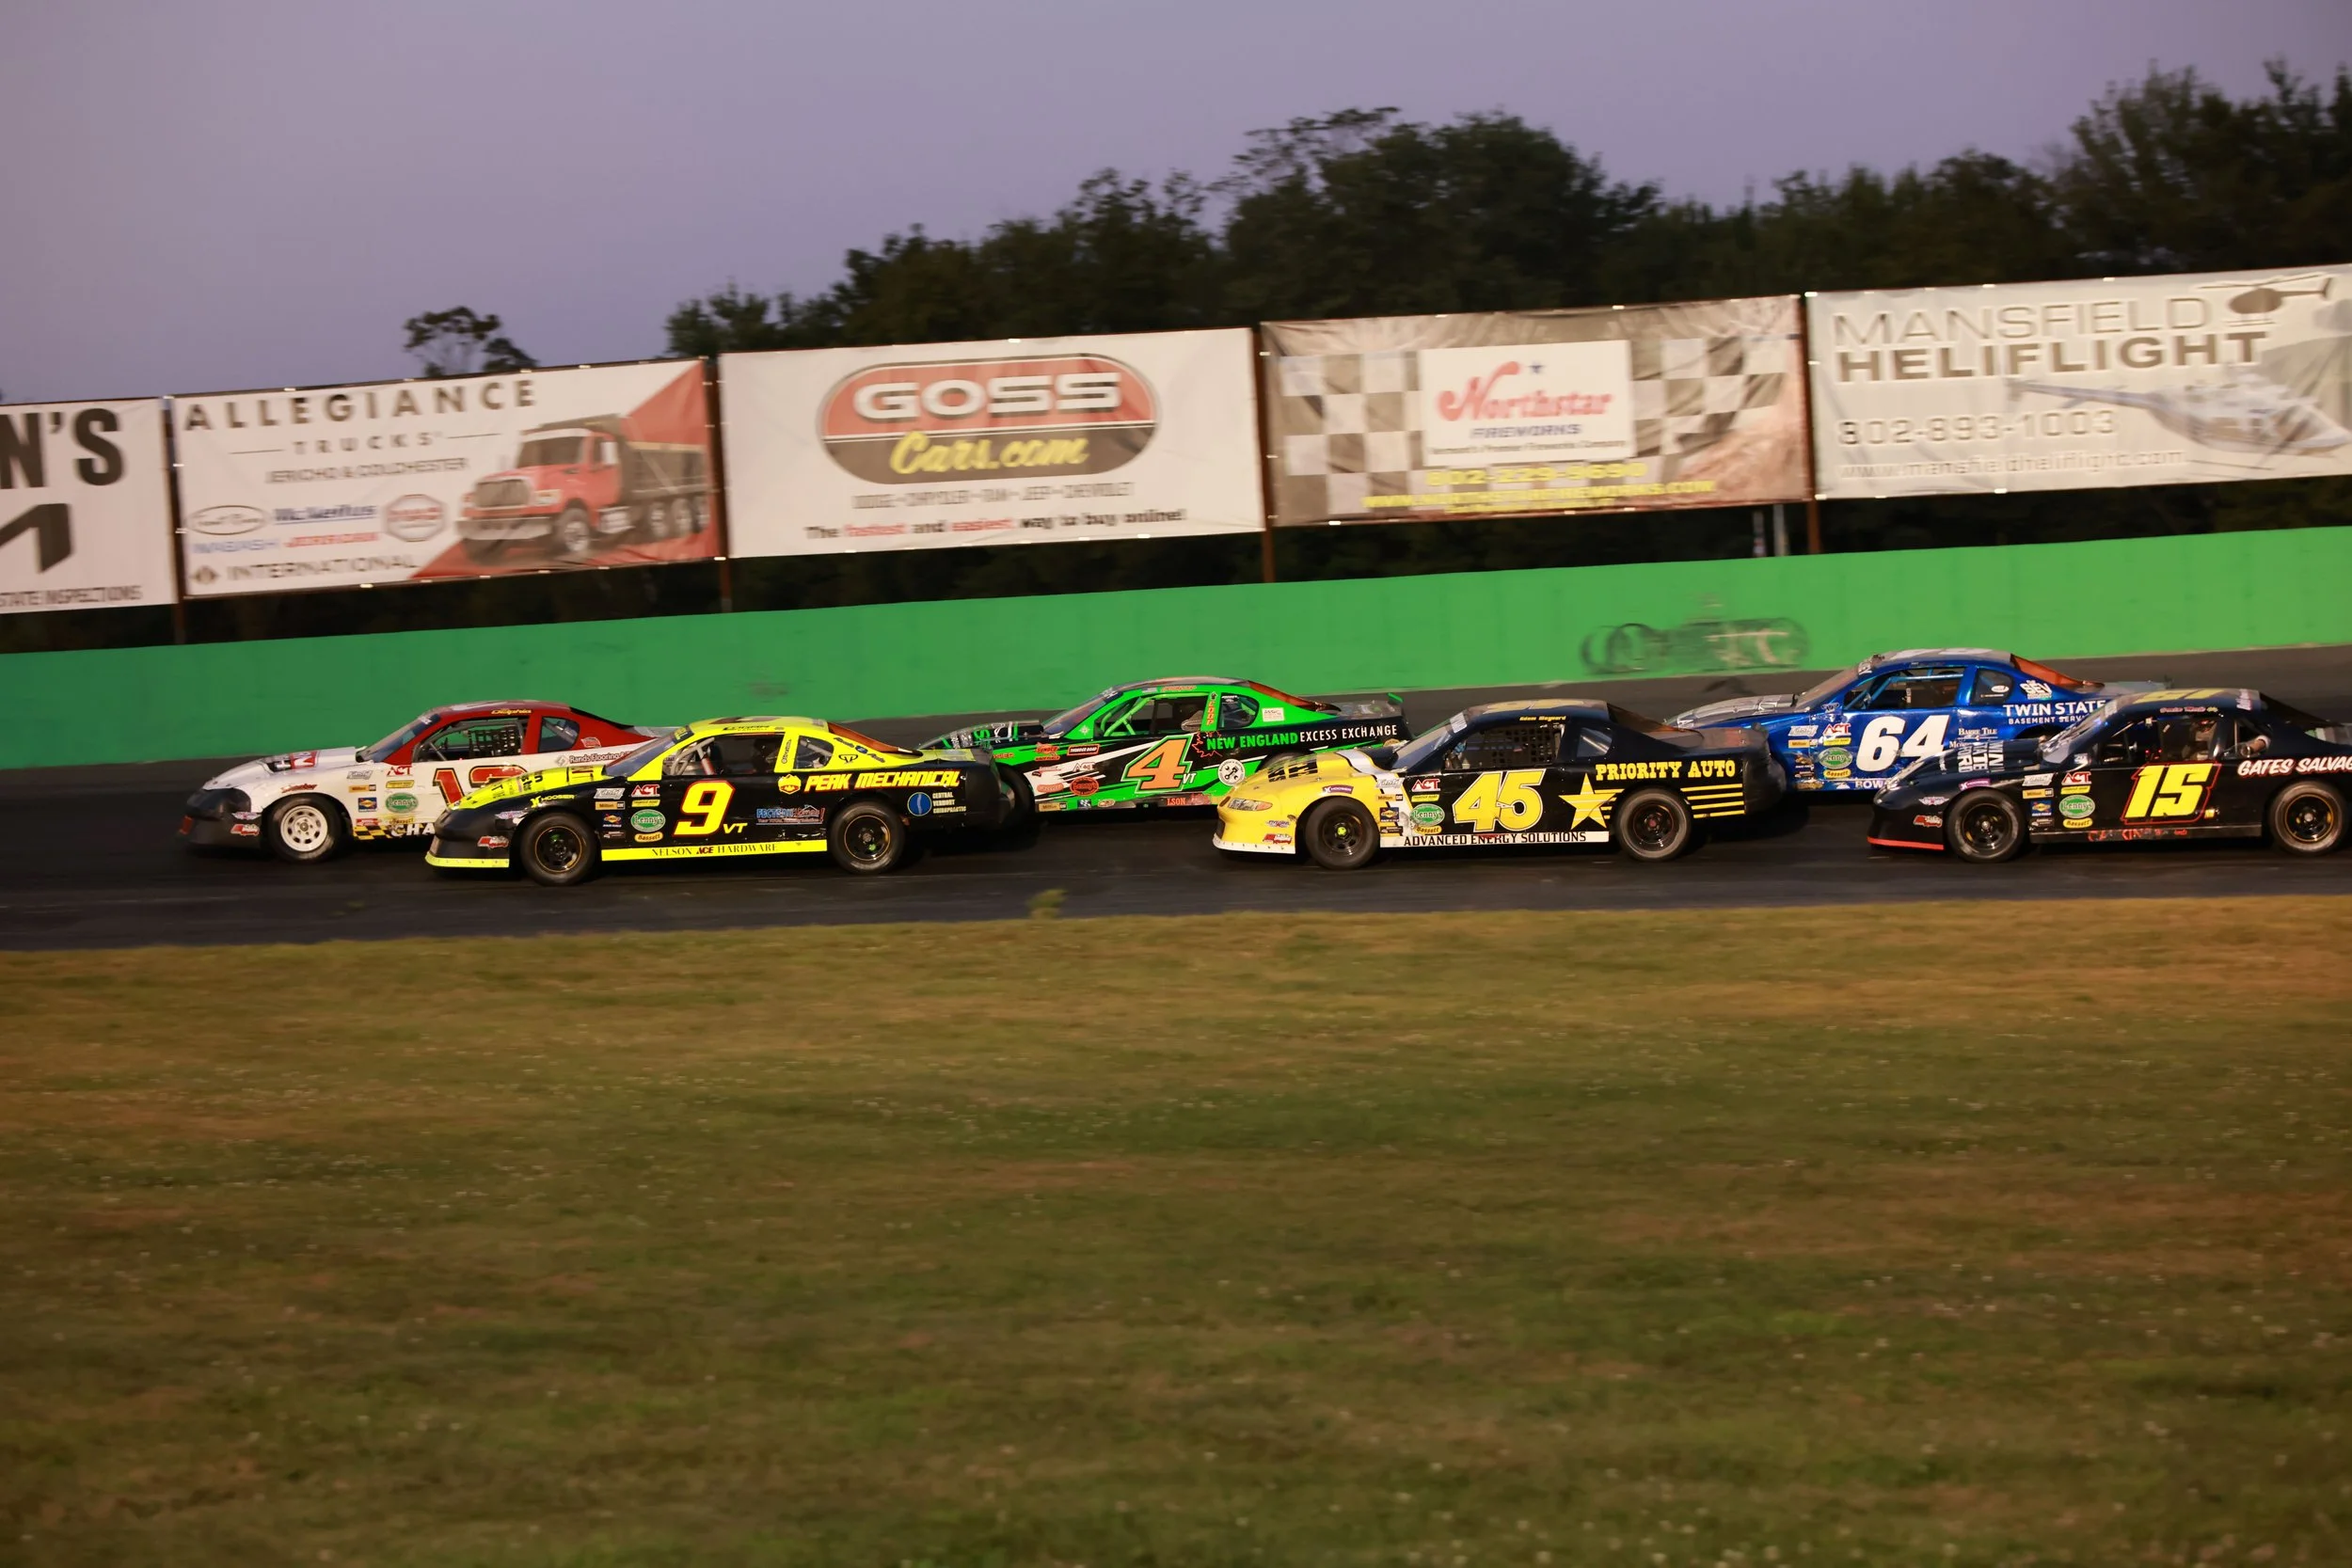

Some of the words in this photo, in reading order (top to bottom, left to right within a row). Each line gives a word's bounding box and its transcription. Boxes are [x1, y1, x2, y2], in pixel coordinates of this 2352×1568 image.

[1833, 296, 2206, 345] MANSFIELD
[1838, 331, 2268, 383] HELIFLIGHT
[853, 372, 1121, 421] GOSS
[1436, 360, 1615, 421] Northstar
[183, 378, 537, 431] ALLEGIANCE
[1470, 423, 1582, 439] FIREWORKS
[1837, 409, 2119, 446] 802-893-1003
[292, 432, 435, 455] TRUCKS
[890, 430, 1089, 474] Cars.com
[804, 525, 839, 539] The
[844, 523, 906, 536] fastest
[912, 519, 944, 533] and
[951, 517, 1013, 531] easiest
[1020, 515, 1052, 530] way
[1059, 513, 1078, 526] to
[1084, 512, 1117, 527] buy
[227, 556, 416, 580] INTERNATIONAL
[2003, 703, 2051, 717] TWIN
[2009, 716, 2056, 724] BASEMENT
[1207, 736, 1236, 751] NEW
[1240, 732, 1299, 749] ENGLAND
[1300, 728, 1337, 742] EXCESS
[1343, 724, 1398, 740] EXCHANGE
[1823, 723, 1851, 736] ACT
[1855, 715, 1951, 771] 64
[568, 754, 591, 765] Rands
[592, 752, 620, 762] Flooring
[1126, 738, 1189, 790] 4
[1595, 761, 1682, 781] PRIORITY
[1688, 759, 1736, 778] AUTO
[2237, 758, 2295, 777] GATES
[386, 765, 412, 776] ACT
[804, 772, 850, 792] PEAK
[854, 769, 961, 789] MECHANICAL
[2061, 771, 2091, 784] ACT
[631, 784, 660, 797] ACT
[1412, 778, 1440, 791] ACT
[2123, 763, 2214, 818] 15
[673, 781, 735, 836] 9
[1453, 768, 1546, 832] 45
[634, 815, 663, 825] Lenny's
[1414, 810, 1443, 820] Lenny's
[723, 822, 748, 834] VT
[1404, 833, 1467, 847] ADVANCED
[1471, 832, 1517, 845] ENERGY
[1520, 832, 1587, 844] SOLUTIONS
[651, 847, 691, 857] NELSON
[696, 847, 713, 855] ACE
[718, 843, 778, 854] HARDWARE
